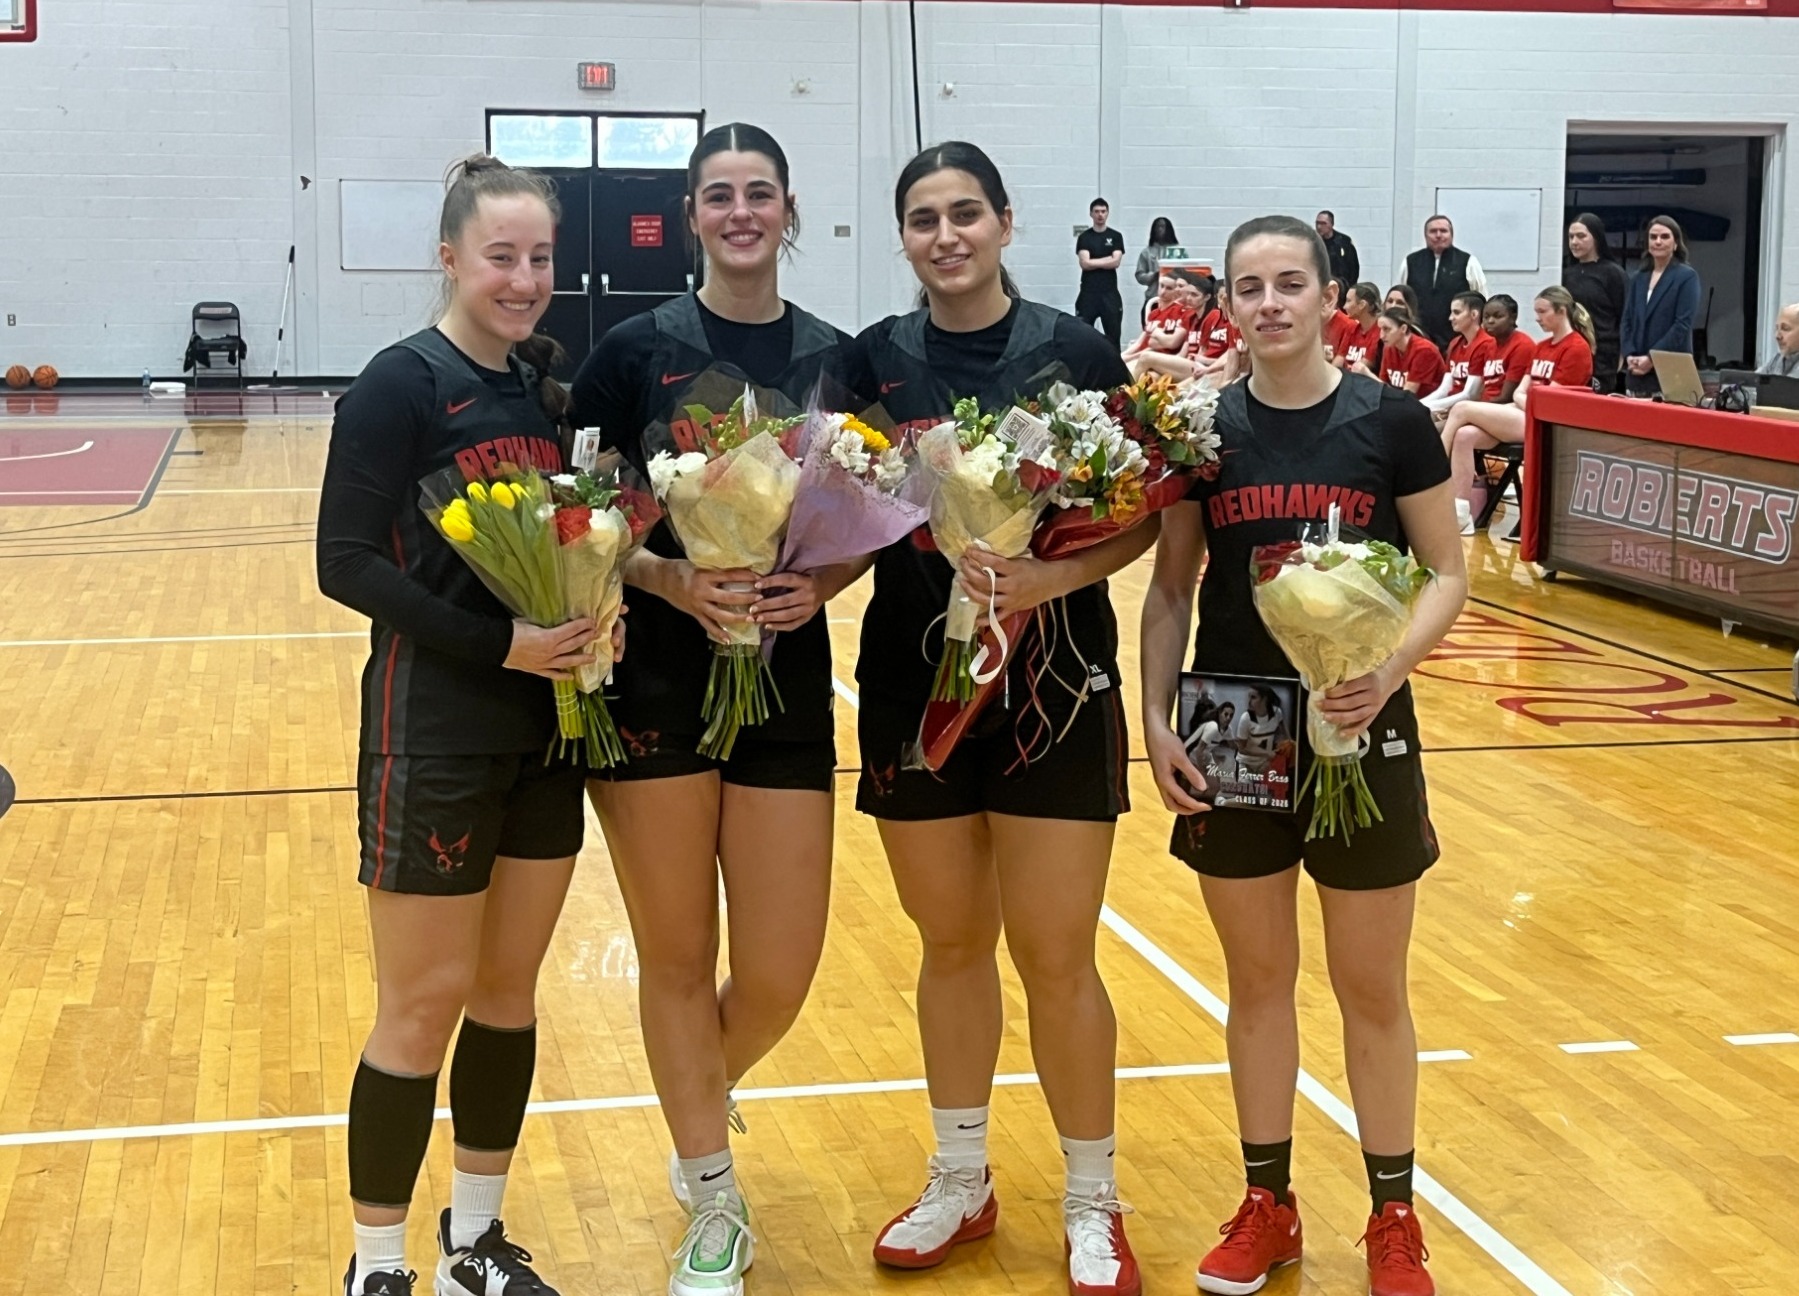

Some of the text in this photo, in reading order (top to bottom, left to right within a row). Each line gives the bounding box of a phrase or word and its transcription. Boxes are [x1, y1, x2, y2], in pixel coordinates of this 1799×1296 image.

[1208, 484, 1376, 529] REDHAWKS
[1571, 455, 1796, 558] ROBERTS
[1610, 538, 1741, 596] BASKETBALL
[1386, 728, 1397, 740] M
[1235, 795, 1256, 805] CLASS
[1259, 797, 1268, 806] OF
